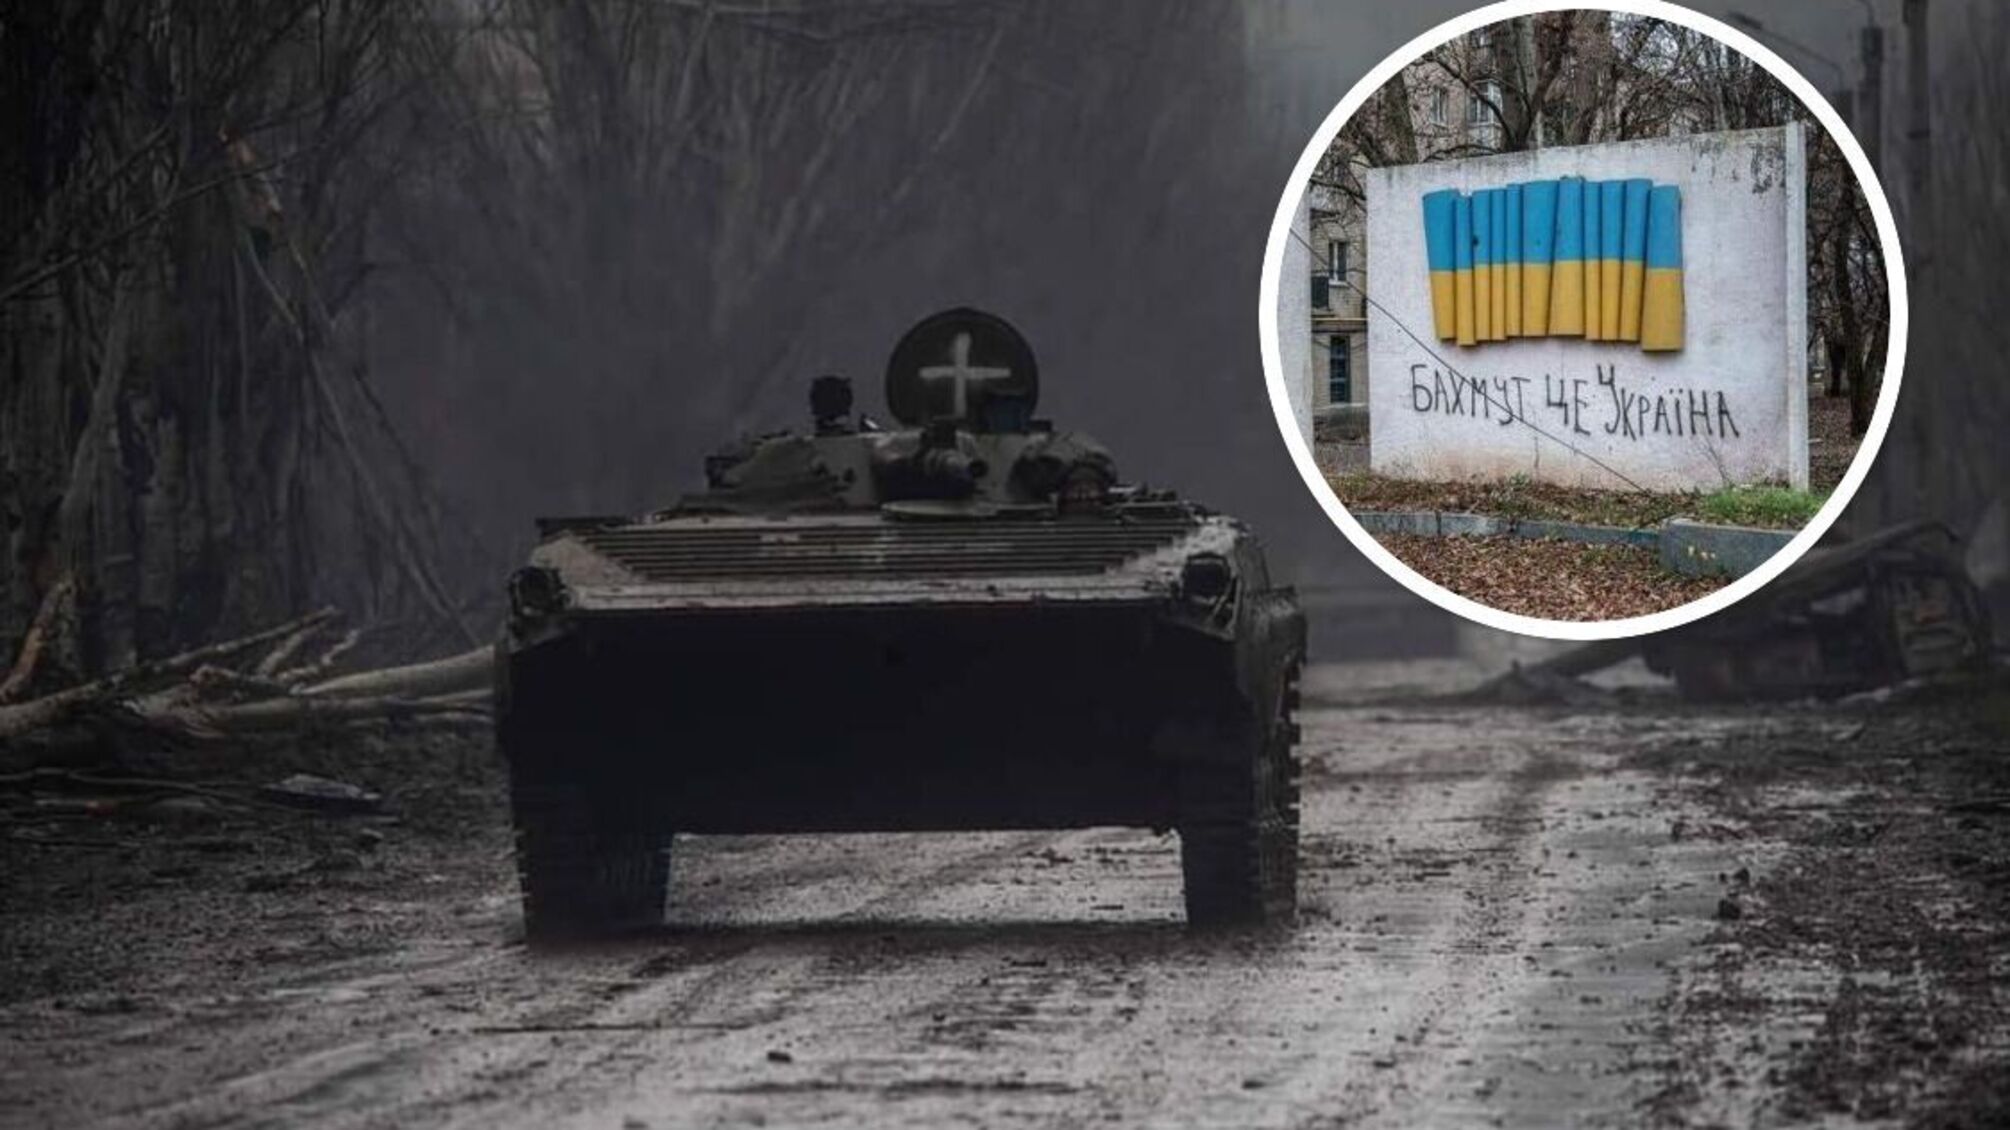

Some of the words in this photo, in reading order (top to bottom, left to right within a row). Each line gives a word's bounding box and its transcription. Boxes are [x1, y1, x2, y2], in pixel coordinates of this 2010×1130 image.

[1411, 364, 1531, 426] БАХМУТ
[1545, 373, 1591, 436] ЦЕ
[1596, 363, 1740, 441] УКРАЇНА
